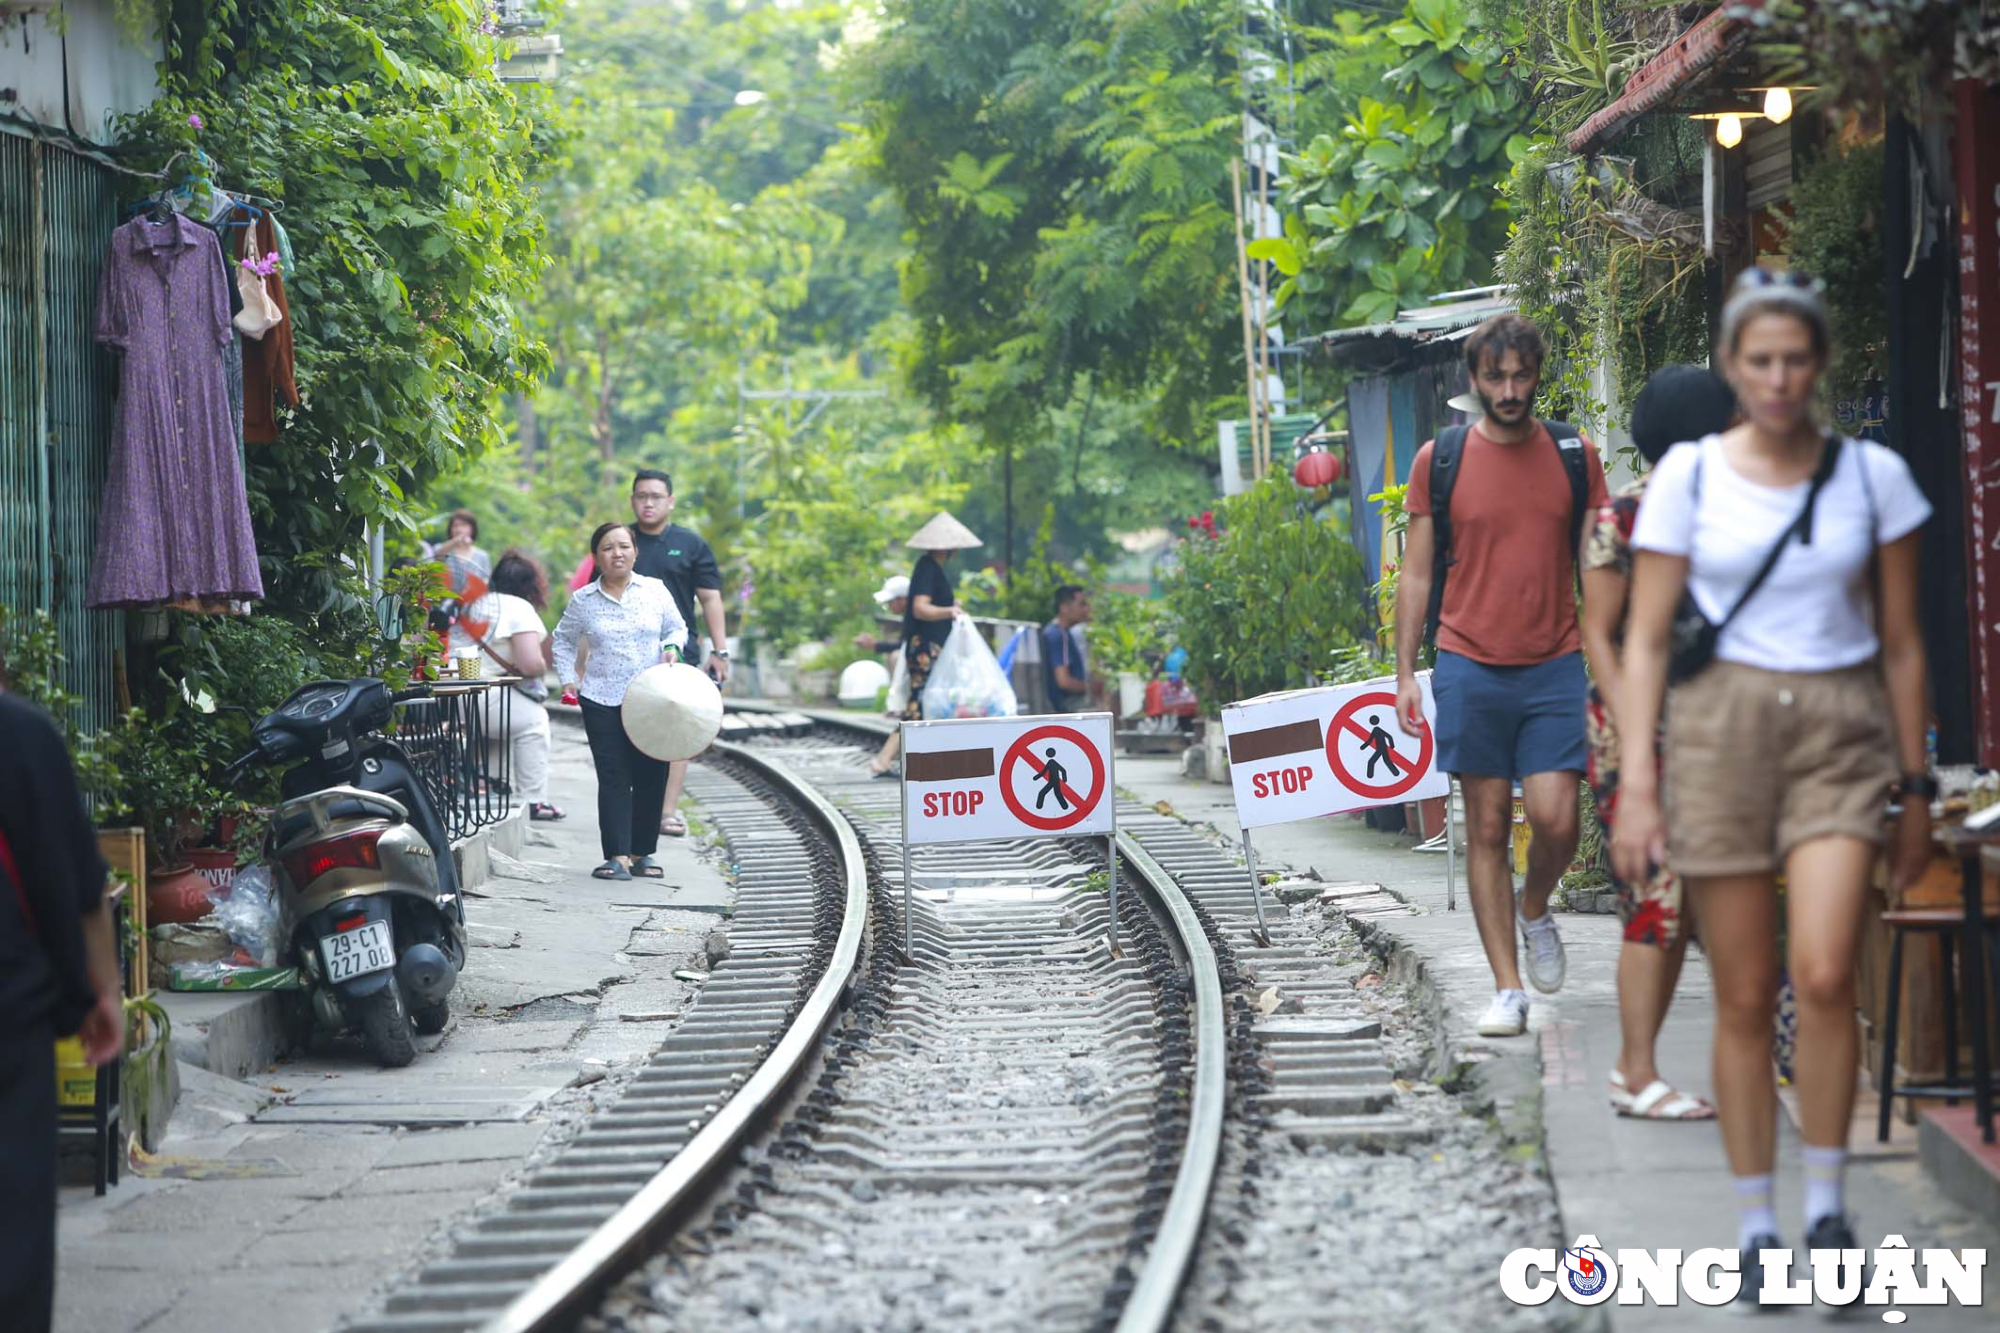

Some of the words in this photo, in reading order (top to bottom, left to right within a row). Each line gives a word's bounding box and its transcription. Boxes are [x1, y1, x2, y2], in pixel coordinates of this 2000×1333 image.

[1252, 765, 1313, 799] STOP
[923, 790, 984, 818] STOP
[330, 926, 379, 957] 29-C1
[330, 947, 391, 979] 227.08
